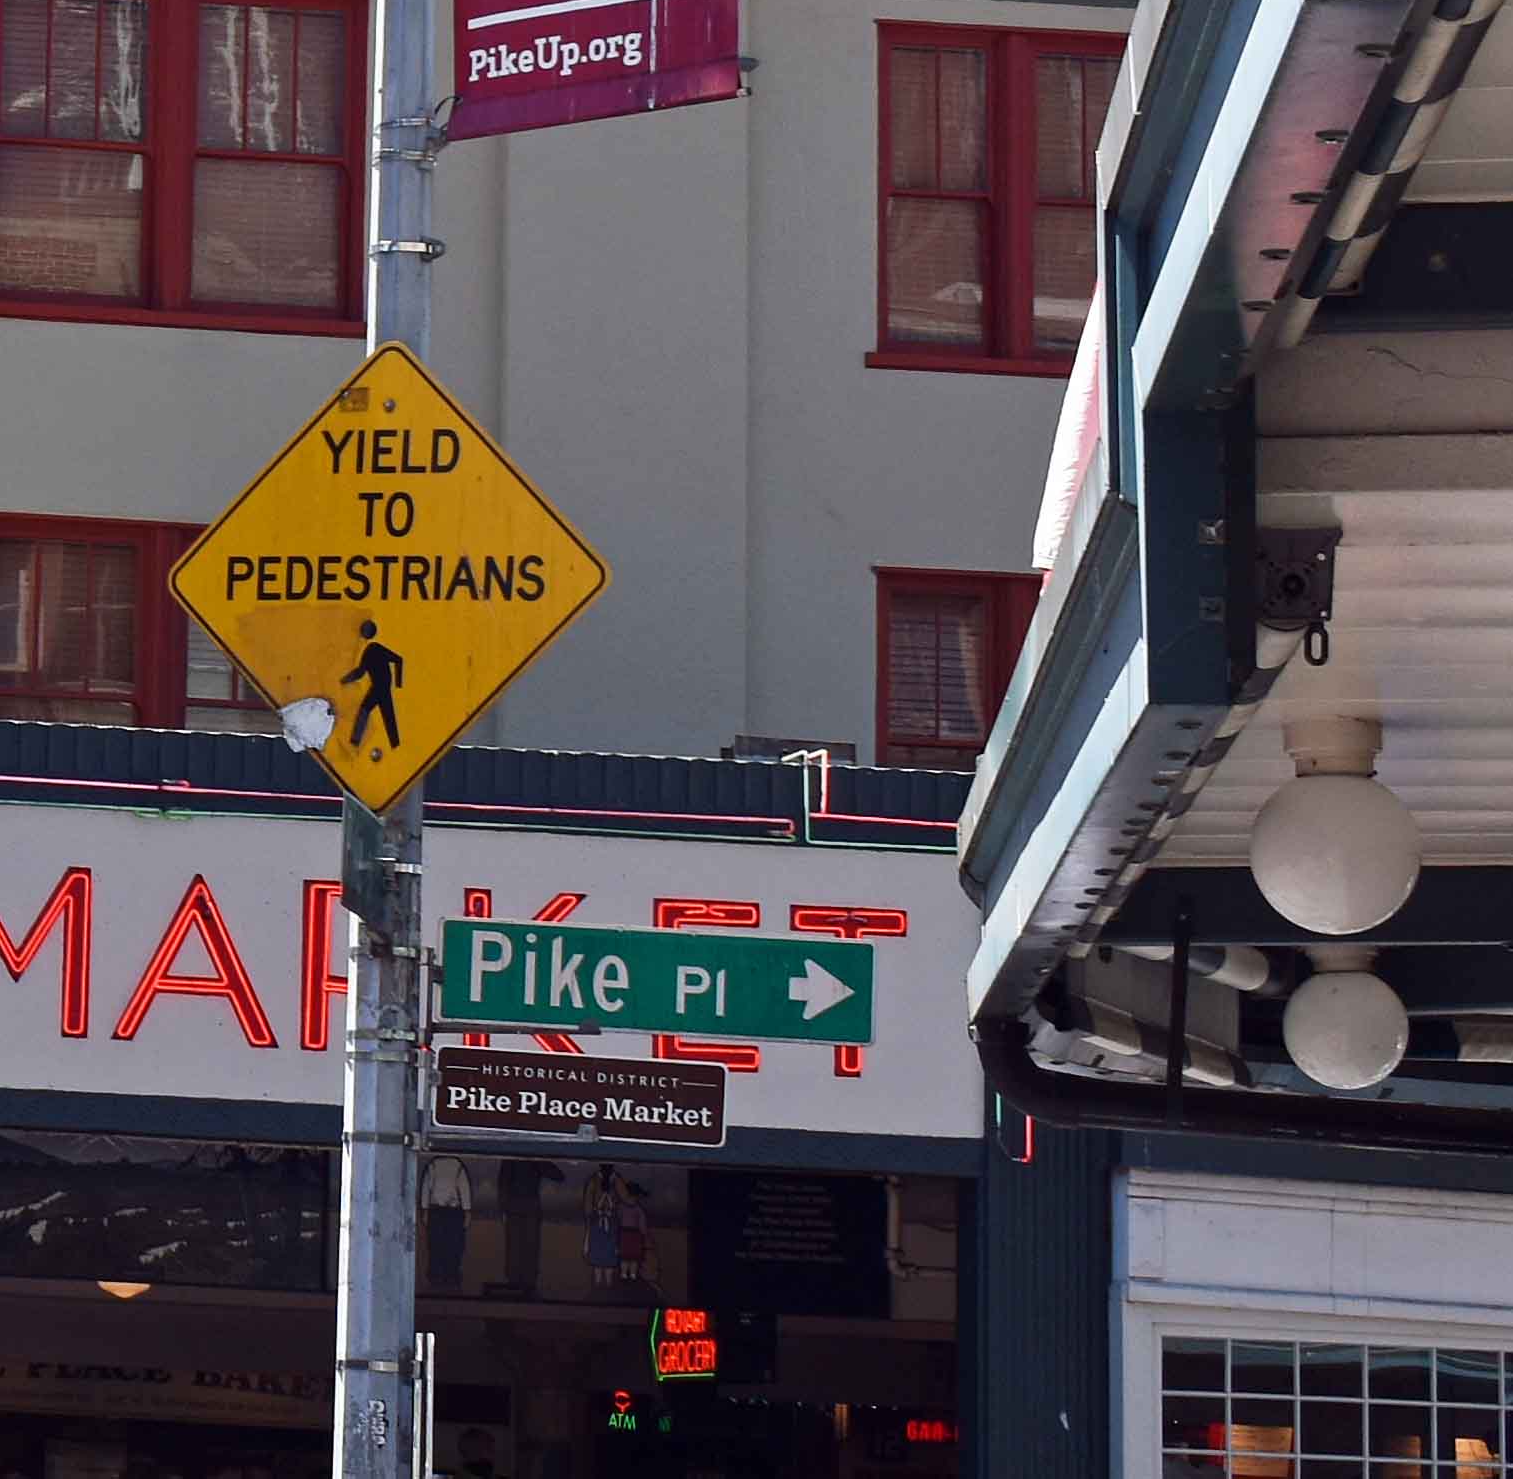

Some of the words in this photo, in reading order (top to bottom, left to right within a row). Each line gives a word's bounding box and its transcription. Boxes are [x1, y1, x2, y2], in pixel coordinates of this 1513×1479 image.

[468, 32, 642, 82] PikeUp.org
[321, 428, 461, 474] YIELD
[358, 492, 415, 538] TO
[226, 555, 546, 602] PEDESTRIANS
[468, 930, 631, 1013] Pike
[481, 1063, 588, 1083] HISTORICAL
[597, 1072, 680, 1088] DISTRICT
[446, 1085, 512, 1113] Pike
[517, 1091, 597, 1119] Place
[603, 1097, 713, 1128] Market
[608, 1413, 636, 1431] ATM
